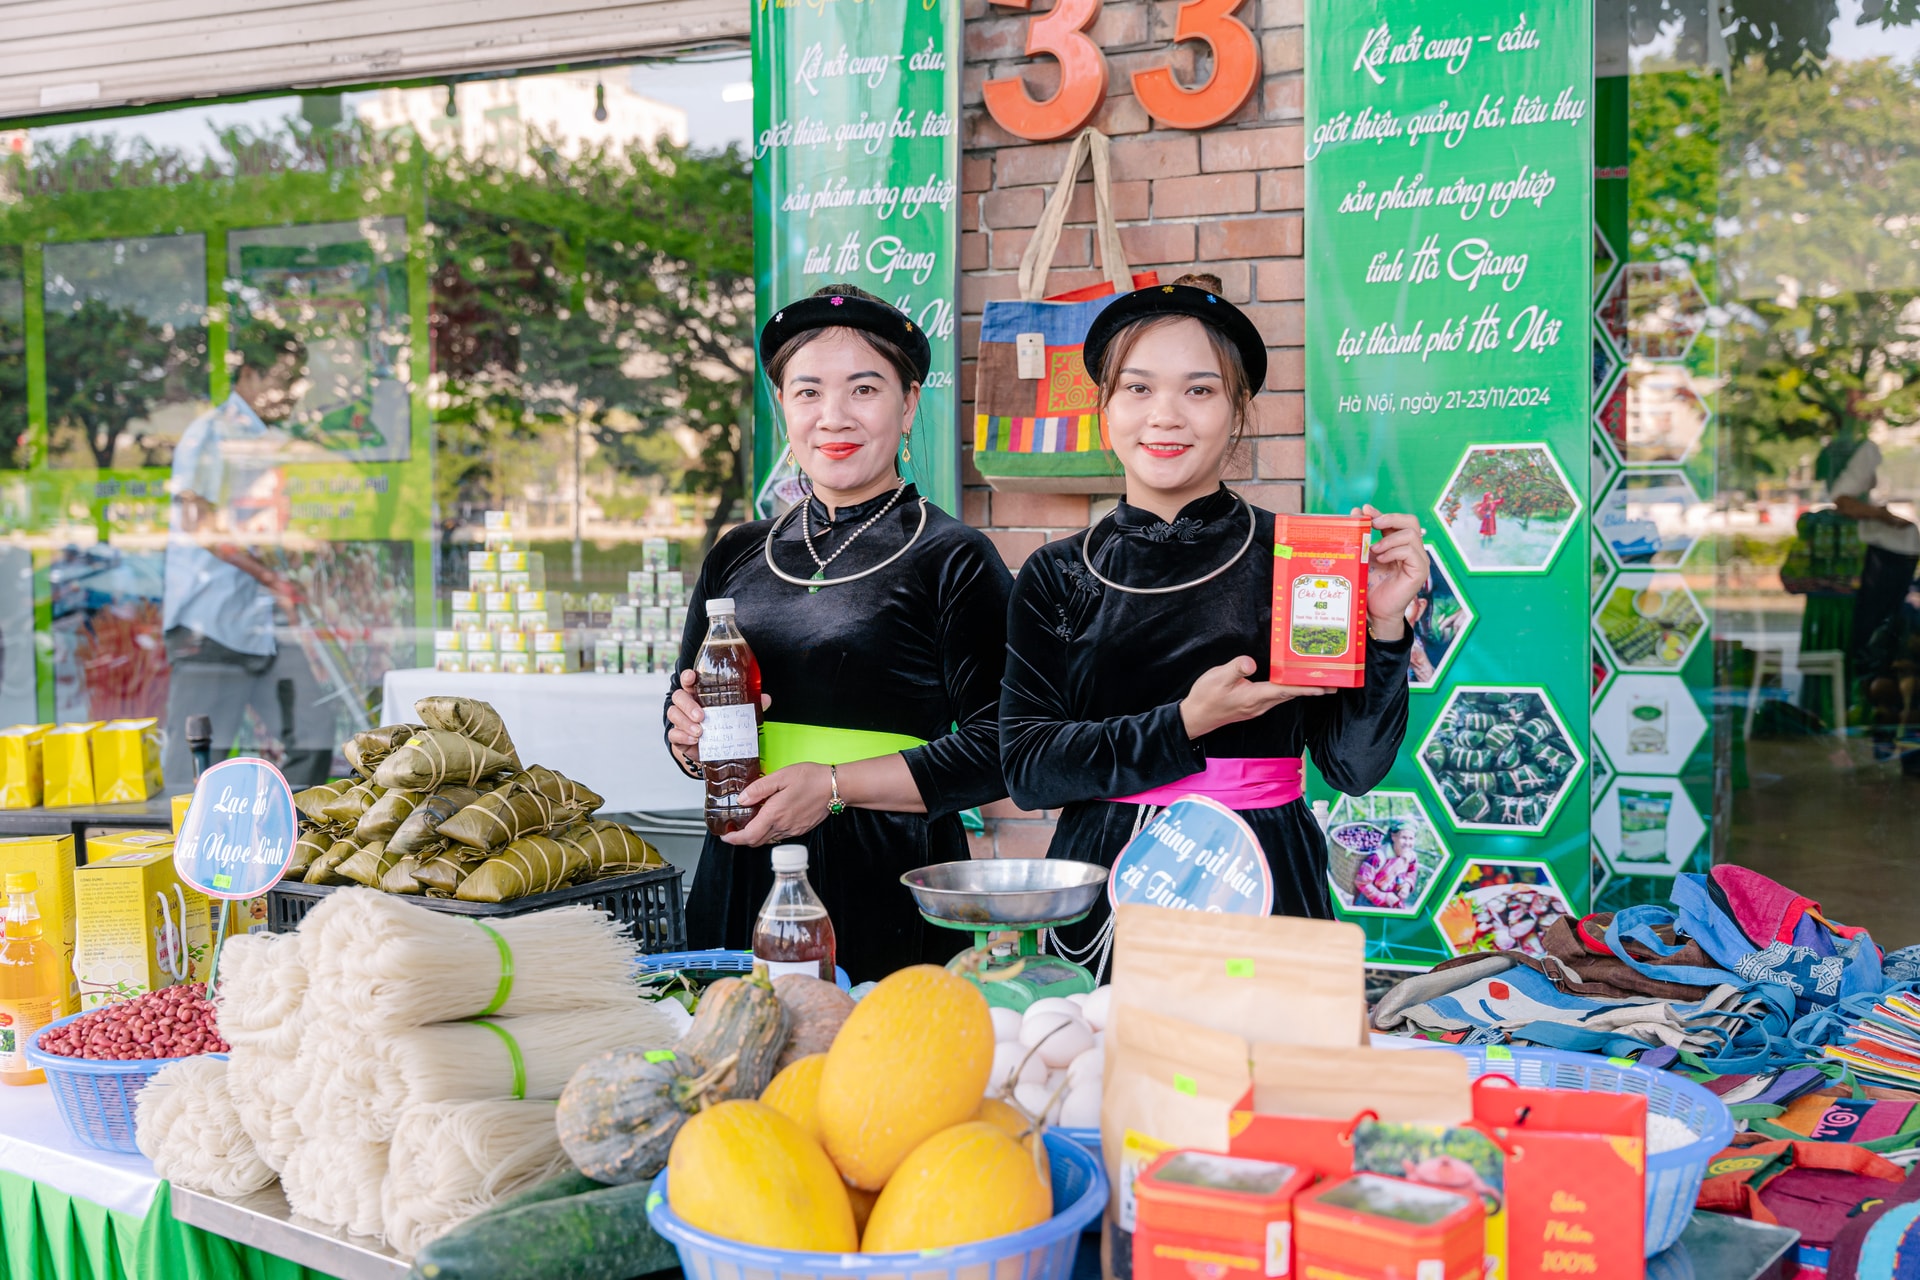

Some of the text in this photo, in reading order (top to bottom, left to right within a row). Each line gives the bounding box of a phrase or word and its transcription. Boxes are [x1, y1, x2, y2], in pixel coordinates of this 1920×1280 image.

[822, 44, 848, 78] nối
[850, 54, 889, 89] cung
[909, 36, 946, 71] cầu,
[1354, 22, 1388, 84] Kết
[1389, 25, 1422, 64] nối
[1425, 36, 1472, 75] cung
[1498, 12, 1540, 51] cầu,
[754, 120, 792, 160] giới
[793, 116, 831, 150] thiệu,
[836, 111, 886, 155] quảng
[890, 107, 917, 138] bá,
[921, 110, 951, 138] tiêu
[1305, 85, 1587, 161] giới thiệu, quảng bá, tiêu thụ
[781, 173, 957, 220] sản phẩm nông nghiệp
[1339, 165, 1556, 221] sản phẩm nông nghiệp
[835, 230, 861, 275] Hà
[866, 235, 936, 285] Giang
[1366, 234, 1528, 292] tỉnh Hà Giang
[1337, 302, 1563, 363] tại thành phố Hà Nội
[1338, 386, 1550, 415] Hà Nội, ngày 21-23/11/2024
[212, 785, 249, 820] Lạc
[203, 832, 251, 870] Ngọc
[252, 836, 284, 866] Linh
[1194, 846, 1229, 879] vịt
[1222, 856, 1258, 899] bầu
[1540, 1250, 1598, 1274] 100%
